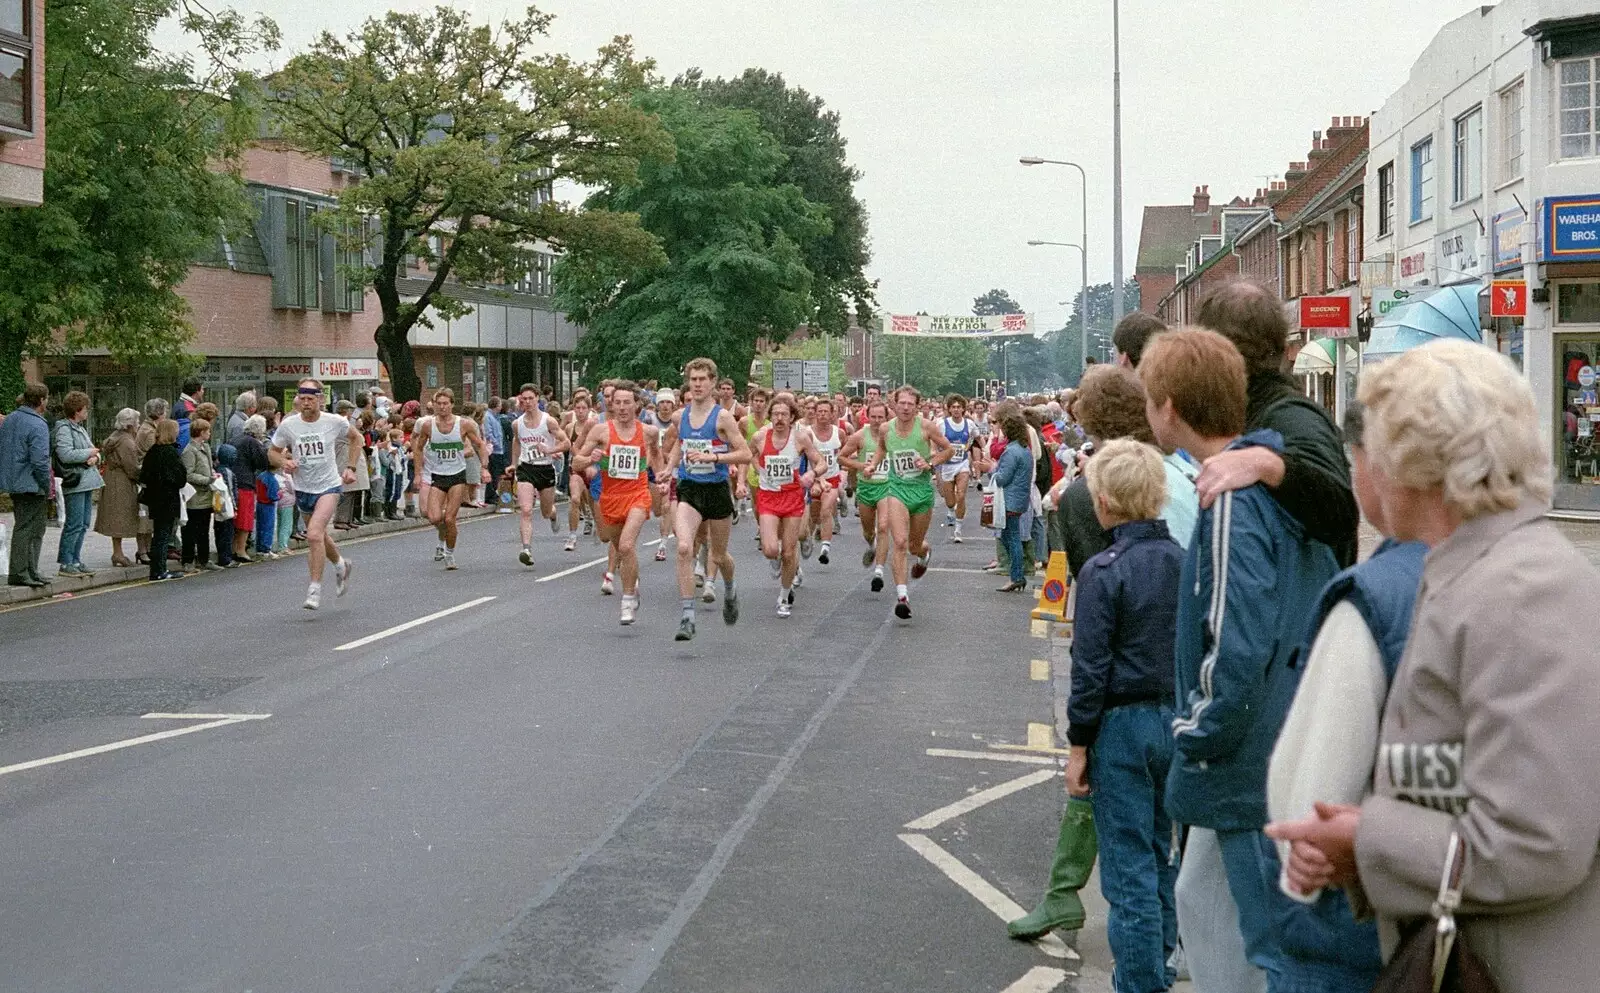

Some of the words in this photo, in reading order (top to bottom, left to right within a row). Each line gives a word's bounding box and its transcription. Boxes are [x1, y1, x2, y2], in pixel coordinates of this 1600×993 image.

[1571, 230, 1599, 241] BROS.
[930, 322, 987, 330] MARATHON
[265, 364, 311, 374] U-SAVE
[298, 442, 324, 456] 1219
[437, 449, 457, 459] 2878
[612, 454, 637, 469] 1861
[766, 464, 792, 477] 2925
